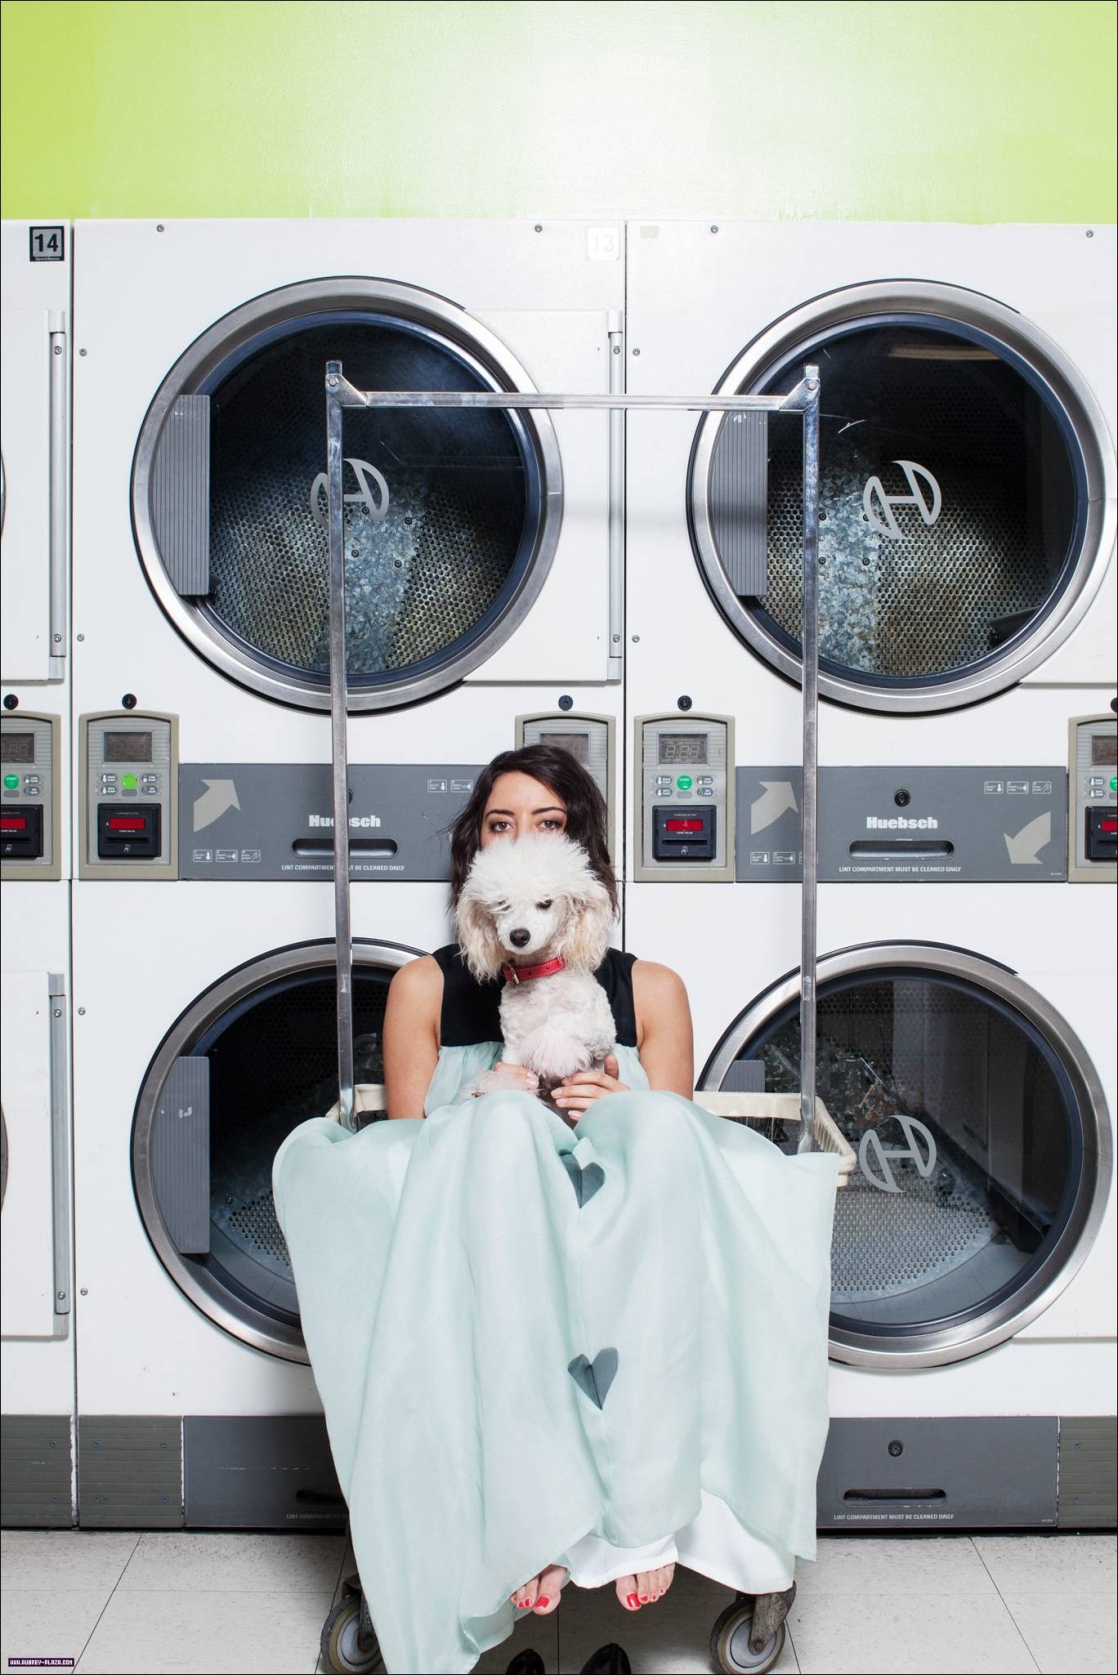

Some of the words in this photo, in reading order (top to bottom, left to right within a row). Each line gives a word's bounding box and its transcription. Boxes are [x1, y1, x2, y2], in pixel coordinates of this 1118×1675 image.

[34, 233, 59, 253] 14
[592, 233, 614, 253] 13
[866, 816, 939, 829] Huebsch
